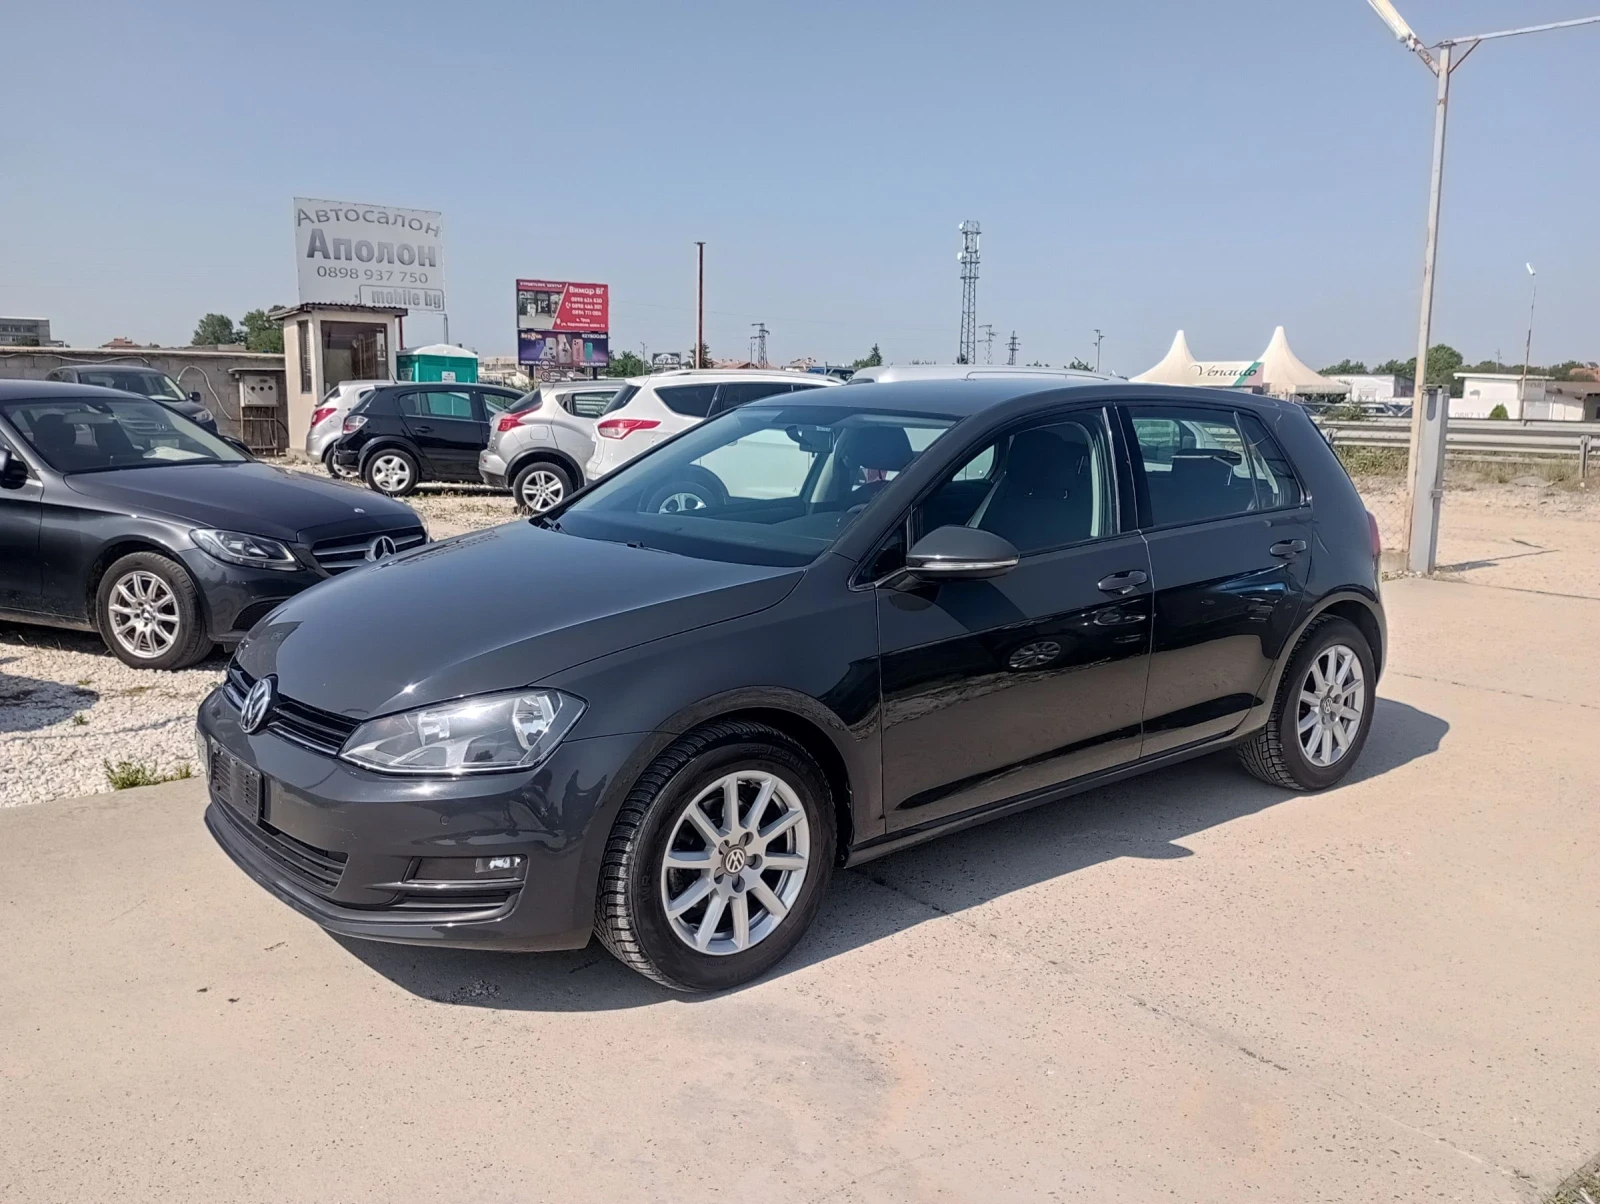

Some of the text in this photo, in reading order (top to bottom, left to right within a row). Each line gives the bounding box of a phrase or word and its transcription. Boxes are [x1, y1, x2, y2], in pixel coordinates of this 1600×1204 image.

[297, 207, 440, 238] Автосалон
[306, 228, 437, 268] Аполон
[317, 265, 428, 284] 0898 937 750
[371, 289, 441, 309] mobile bg
